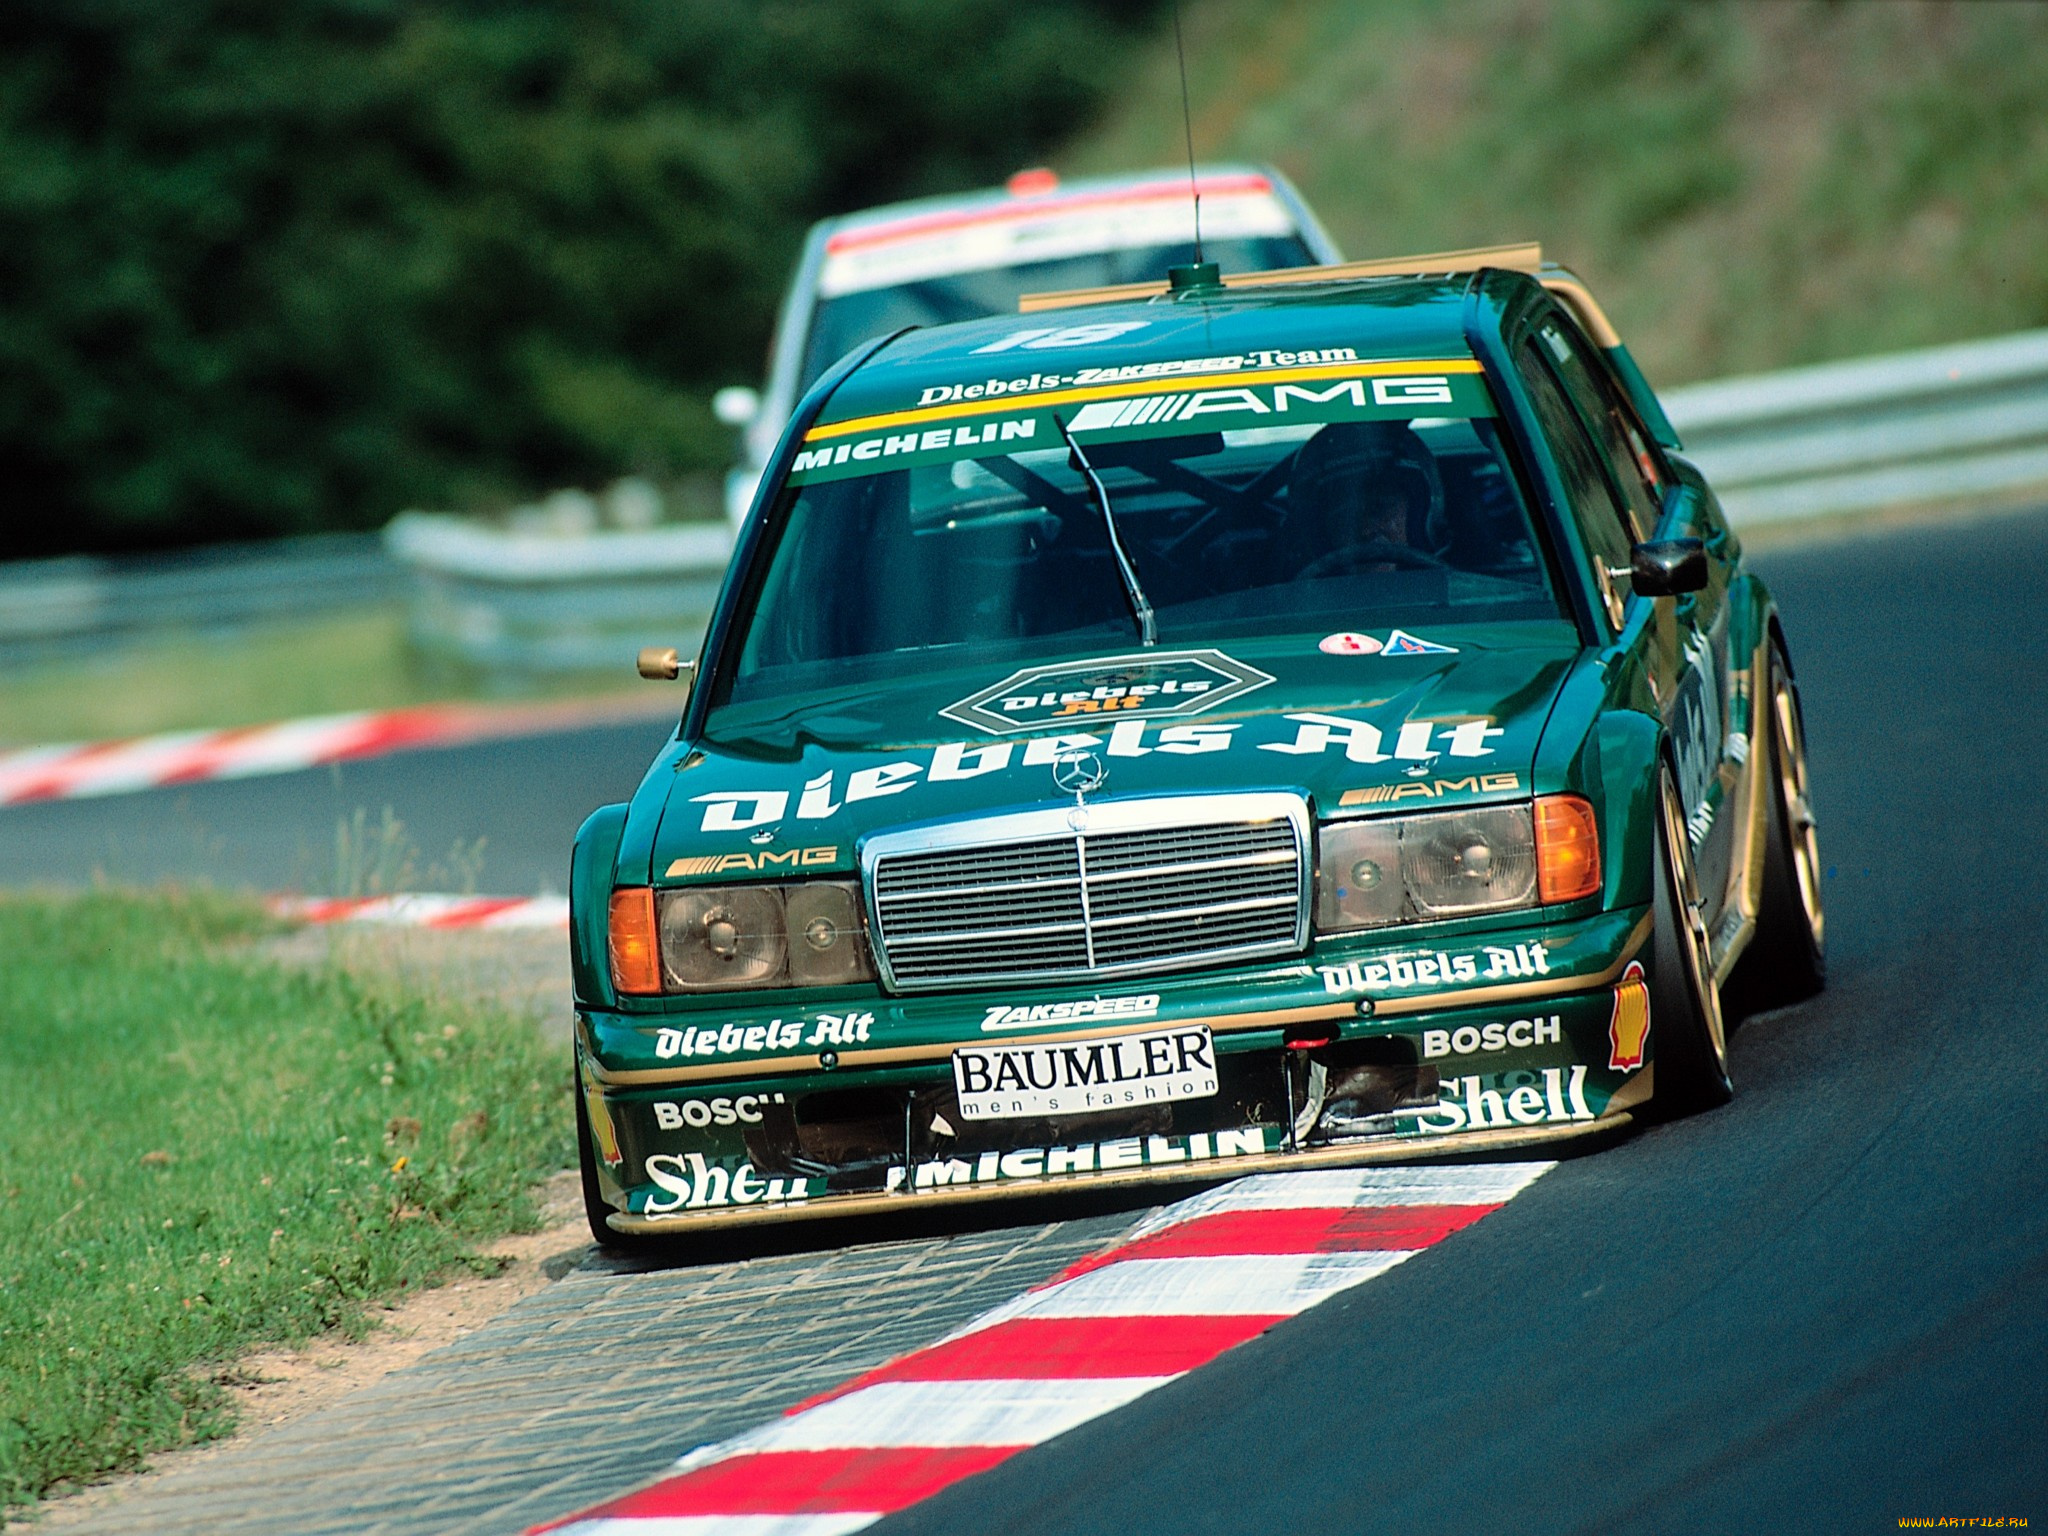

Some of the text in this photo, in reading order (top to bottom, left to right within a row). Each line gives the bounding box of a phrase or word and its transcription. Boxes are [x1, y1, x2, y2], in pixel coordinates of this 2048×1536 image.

[1176, 376, 1452, 420] AMG
[791, 418, 1037, 472] MICHELIN
[1000, 680, 1212, 711] Diebels
[1051, 694, 1145, 716] Alt
[688, 712, 1504, 832] Diebels Alt
[1391, 773, 1519, 800] AMG
[715, 846, 838, 873] AMG
[1316, 943, 1550, 995] Diebels Alt
[980, 994, 1160, 1032] ZAKSPEED
[655, 1012, 875, 1060] Diebels Alt
[1423, 1015, 1561, 1058] BOSCH
[957, 1032, 1213, 1094] BÄUMLER
[653, 1093, 785, 1131] BOSC
[963, 1079, 1216, 1115] men's fashion
[1417, 1065, 1595, 1134] Shell
